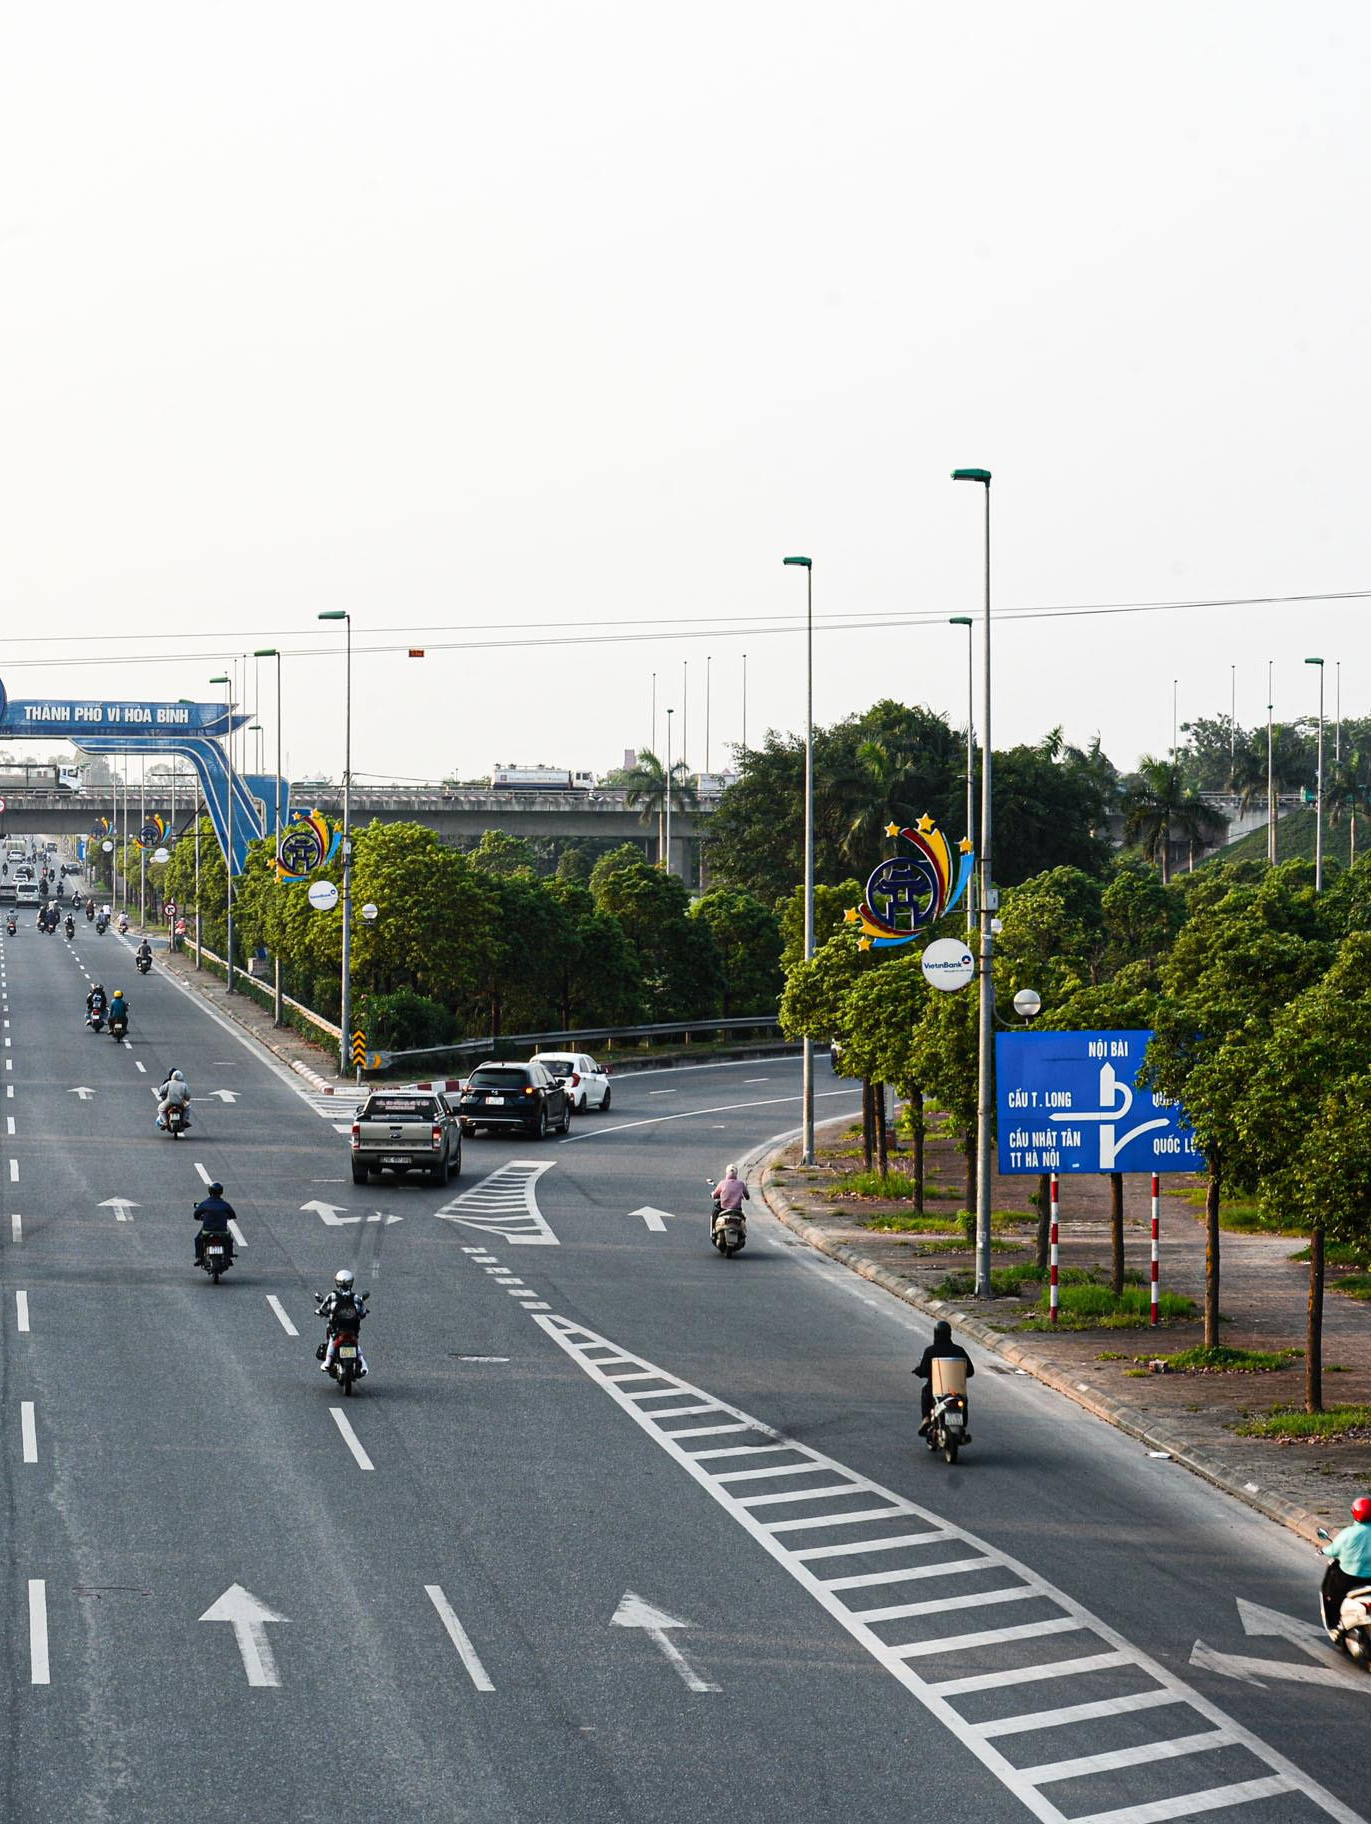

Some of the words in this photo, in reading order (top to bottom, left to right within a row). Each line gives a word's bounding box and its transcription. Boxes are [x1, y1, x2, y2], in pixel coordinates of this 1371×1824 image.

[24, 704, 70, 721] THÀNH
[75, 703, 102, 722] PHỐ
[107, 705, 121, 722] VÌ
[125, 706, 152, 723] HÒA
[157, 706, 189, 723] BÌNH
[1088, 1039, 1108, 1060] NỘI
[1110, 1039, 1128, 1057] BÀI
[1045, 1092, 1072, 1107] LONG
[1032, 1128, 1058, 1149] NHẬT
[1061, 1128, 1081, 1147] TÂN
[1153, 1134, 1181, 1156] QUỐC
[1010, 1152, 1022, 1168] TT
[1025, 1149, 1039, 1167] HÀ
[1042, 1148, 1060, 1170] NỘI
